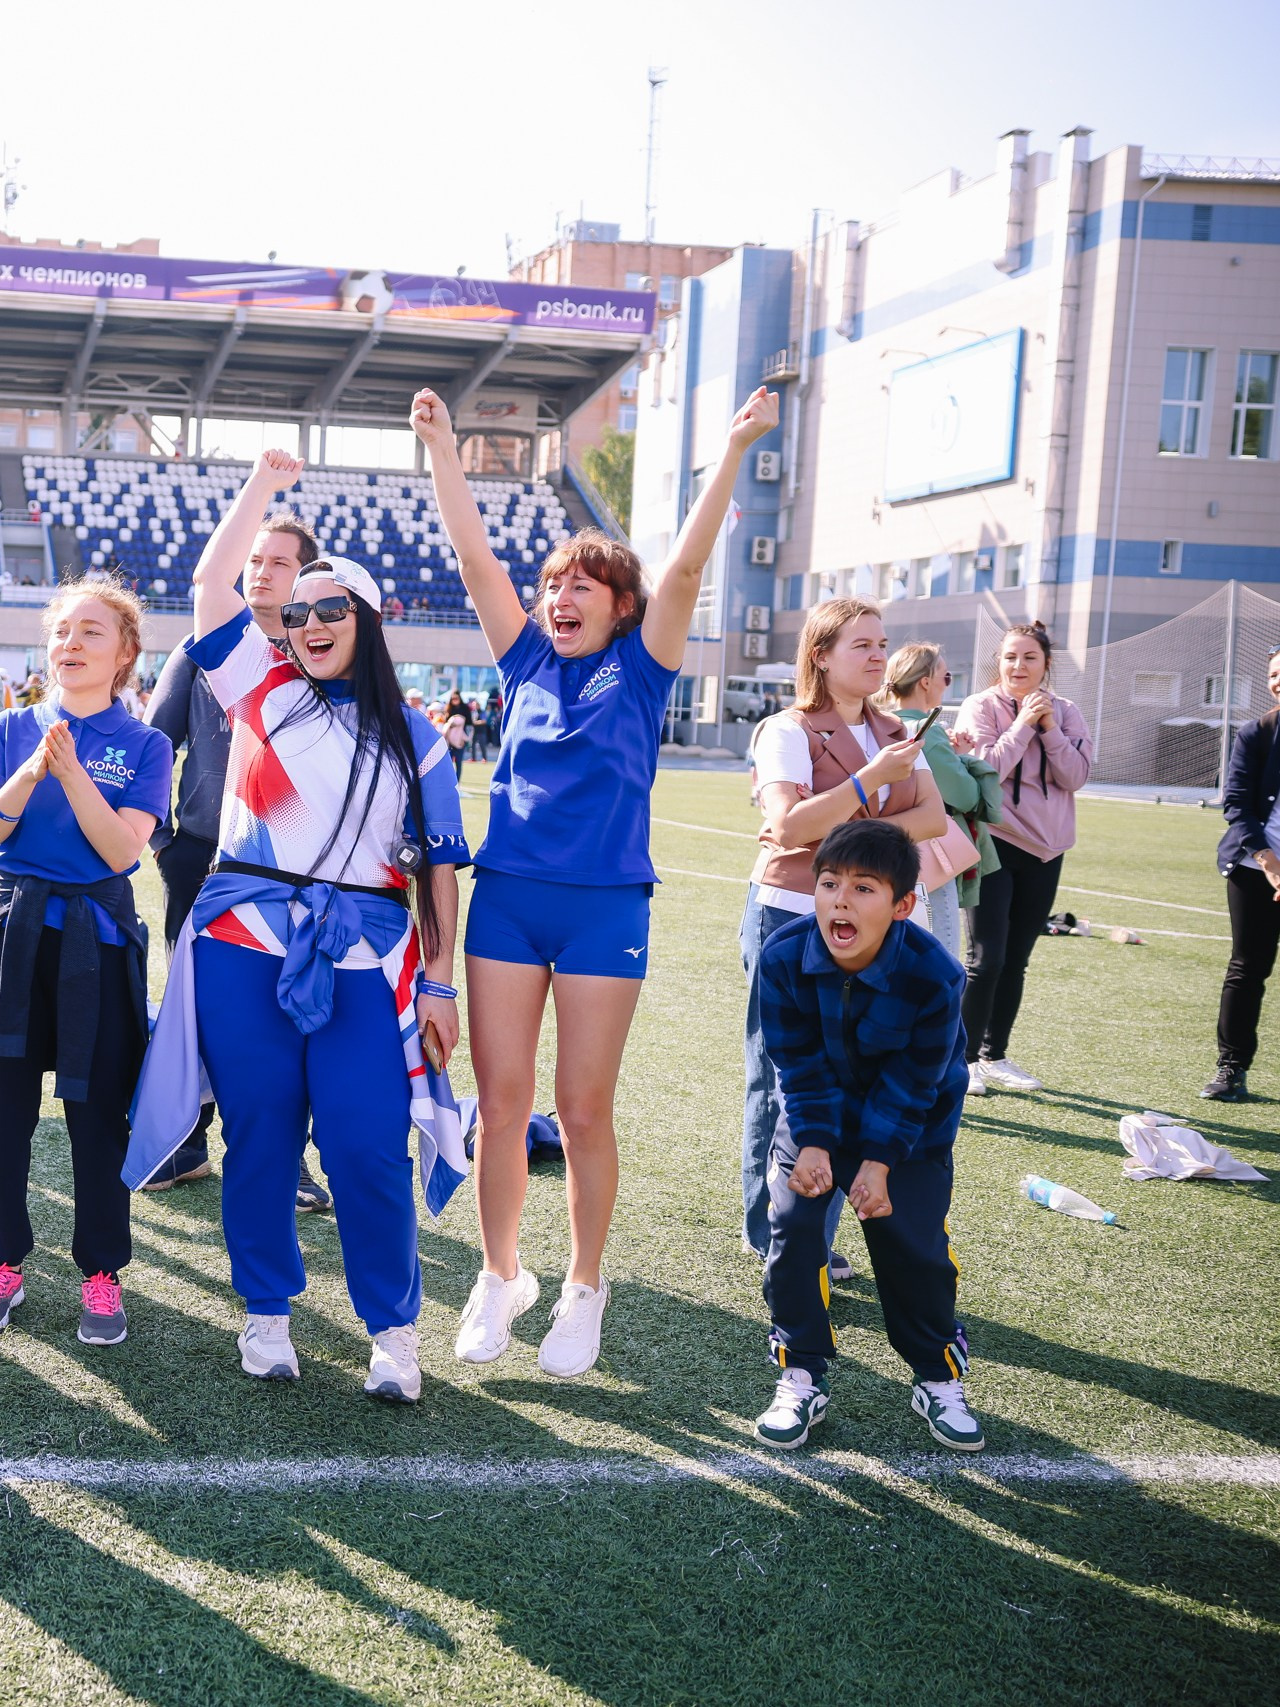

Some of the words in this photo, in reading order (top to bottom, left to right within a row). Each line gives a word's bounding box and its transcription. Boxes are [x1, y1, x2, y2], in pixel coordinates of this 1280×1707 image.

[19, 264, 148, 289] чемпионов
[536, 297, 645, 323] psbank.ru
[578, 662, 621, 701] КОМОС
[587, 674, 616, 697] МИЛКОМ
[86, 759, 136, 781] КОМОС
[93, 769, 126, 784] МИЛКОМ
